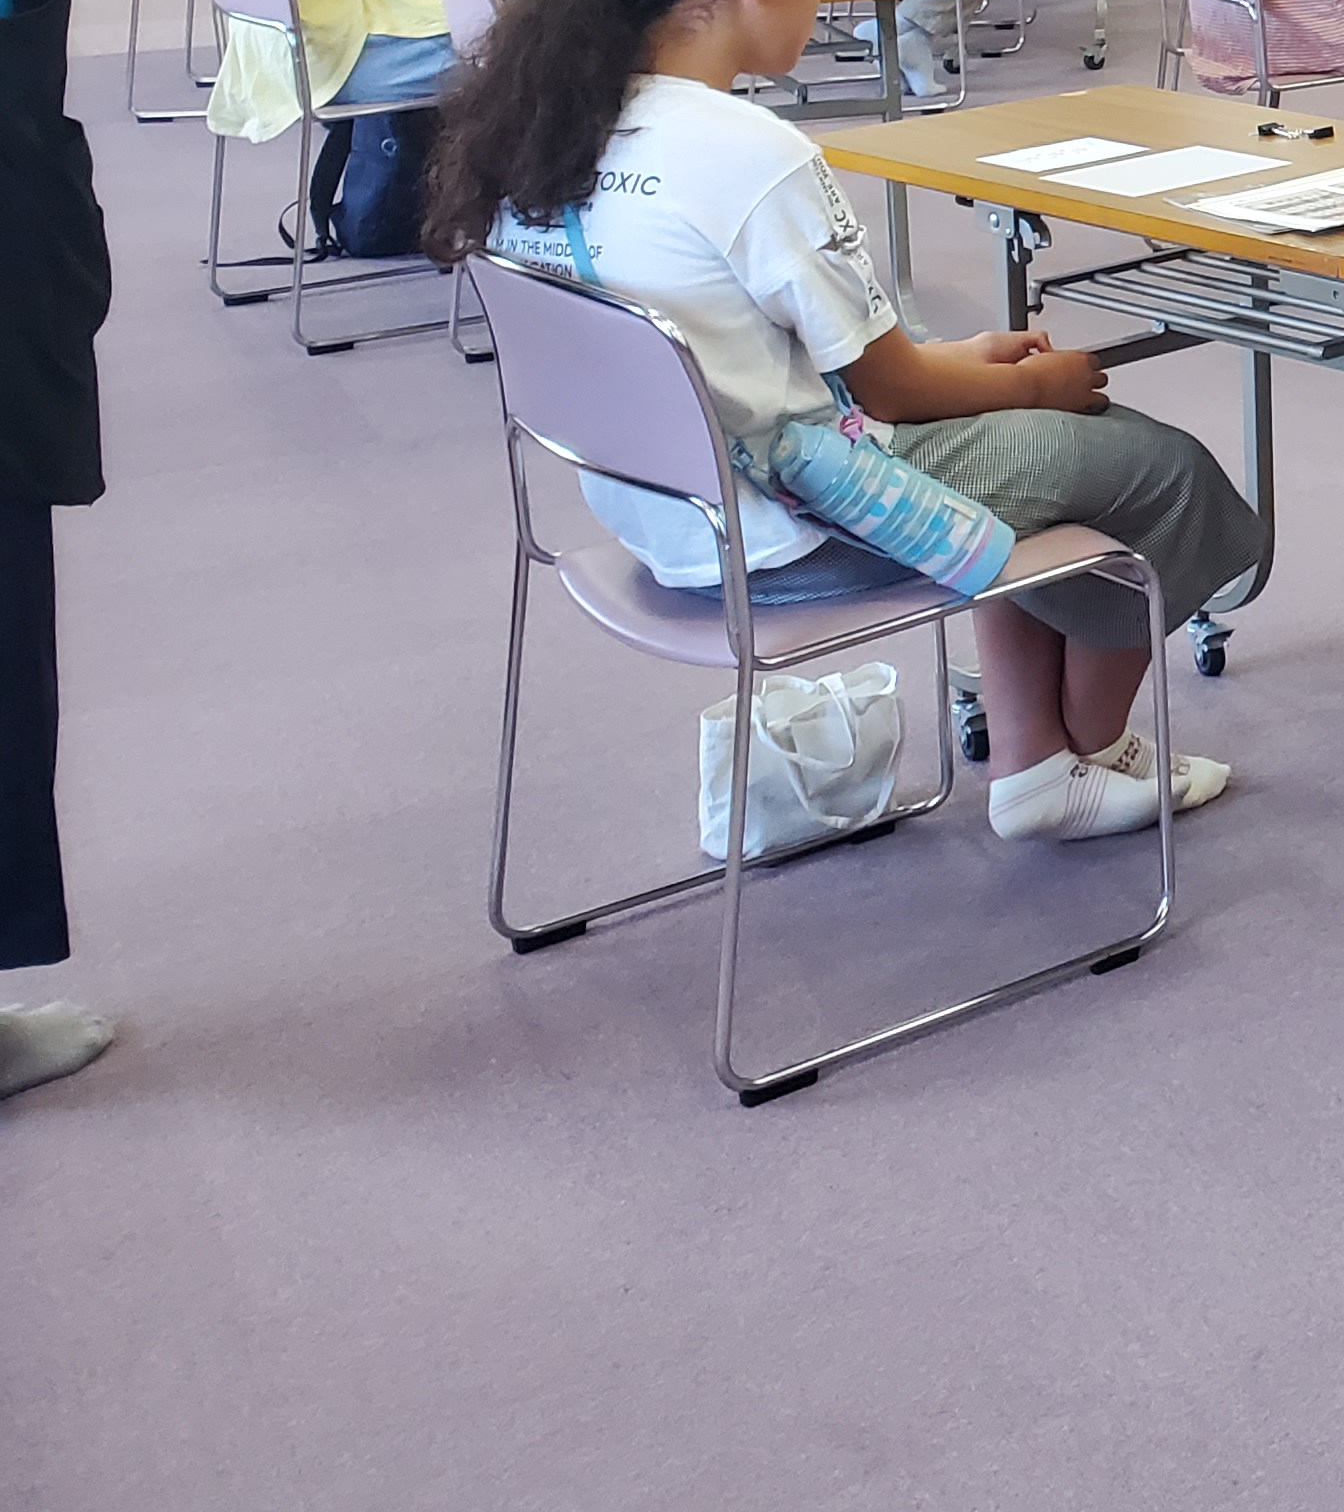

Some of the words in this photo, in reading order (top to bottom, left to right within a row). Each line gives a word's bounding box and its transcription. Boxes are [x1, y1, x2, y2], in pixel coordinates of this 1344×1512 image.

[520, 240, 541, 255] THE
[544, 241, 573, 258] MIDD
[588, 245, 603, 261] OF
